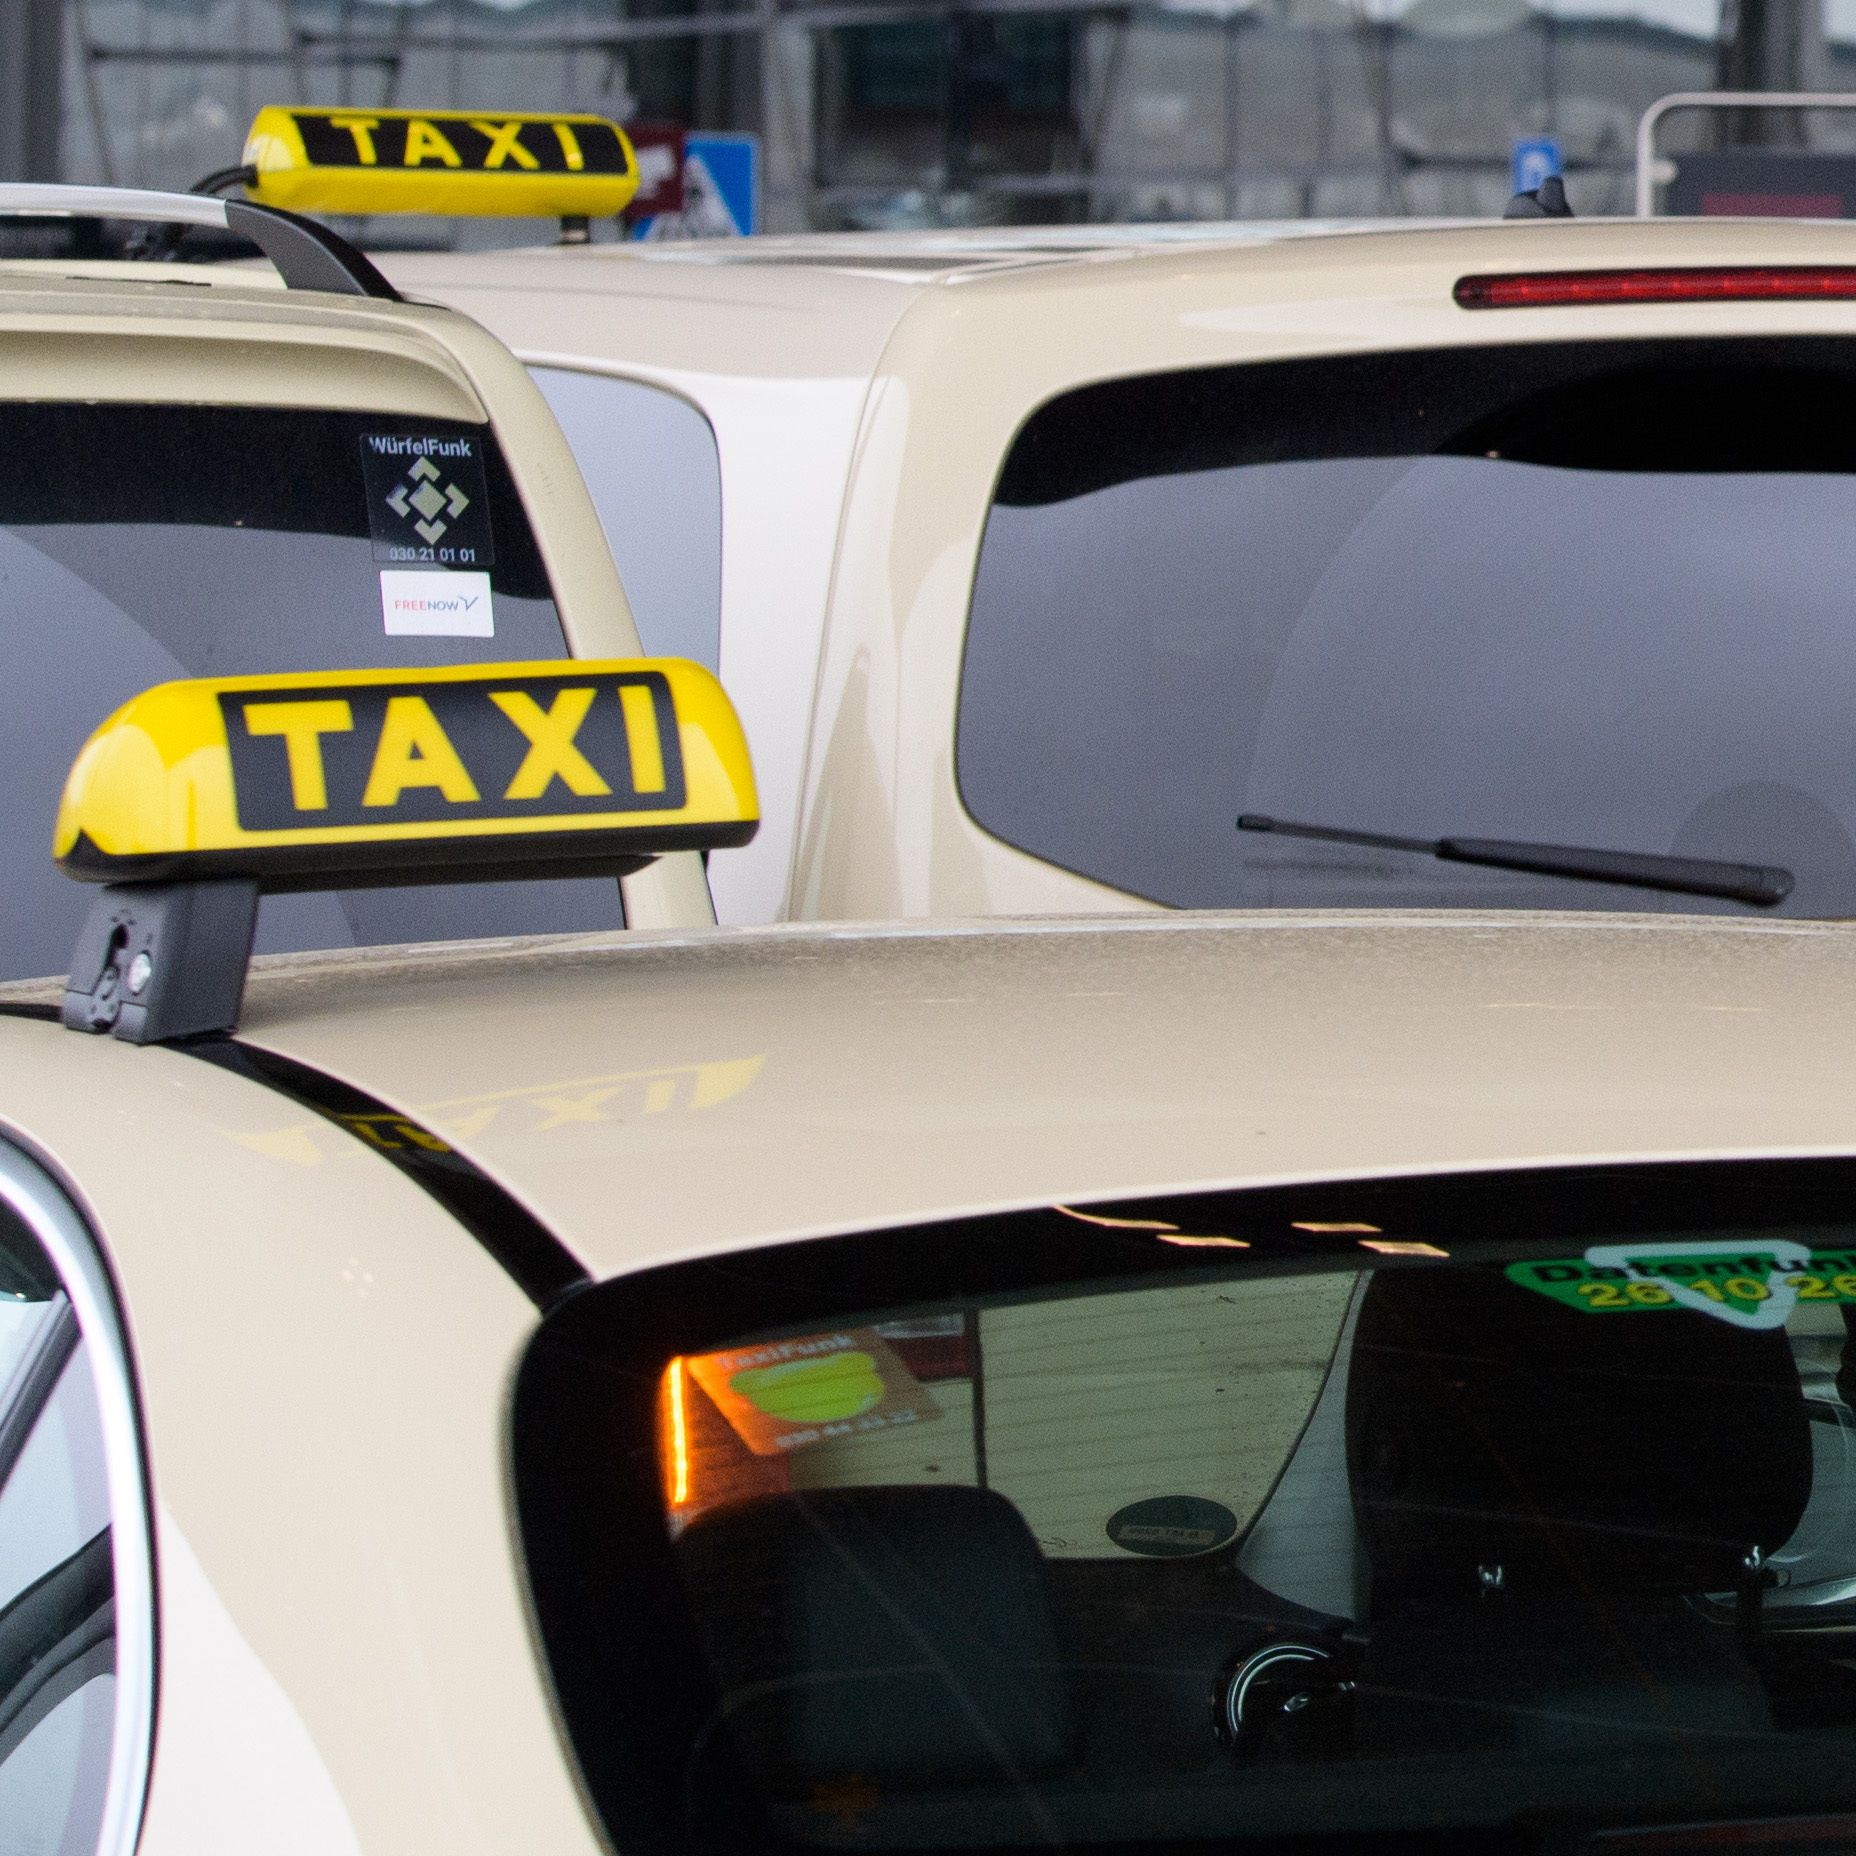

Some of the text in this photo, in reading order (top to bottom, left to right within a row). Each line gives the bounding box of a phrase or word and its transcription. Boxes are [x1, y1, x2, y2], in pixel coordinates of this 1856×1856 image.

[332, 116, 586, 171] TAXI
[369, 436, 472, 457] WürfelFunk
[389, 547, 476, 562] 030 21 01 01
[244, 685, 667, 812] TAXI
[1576, 1279, 1676, 1307] 26
[1688, 1276, 1773, 1303] 10
